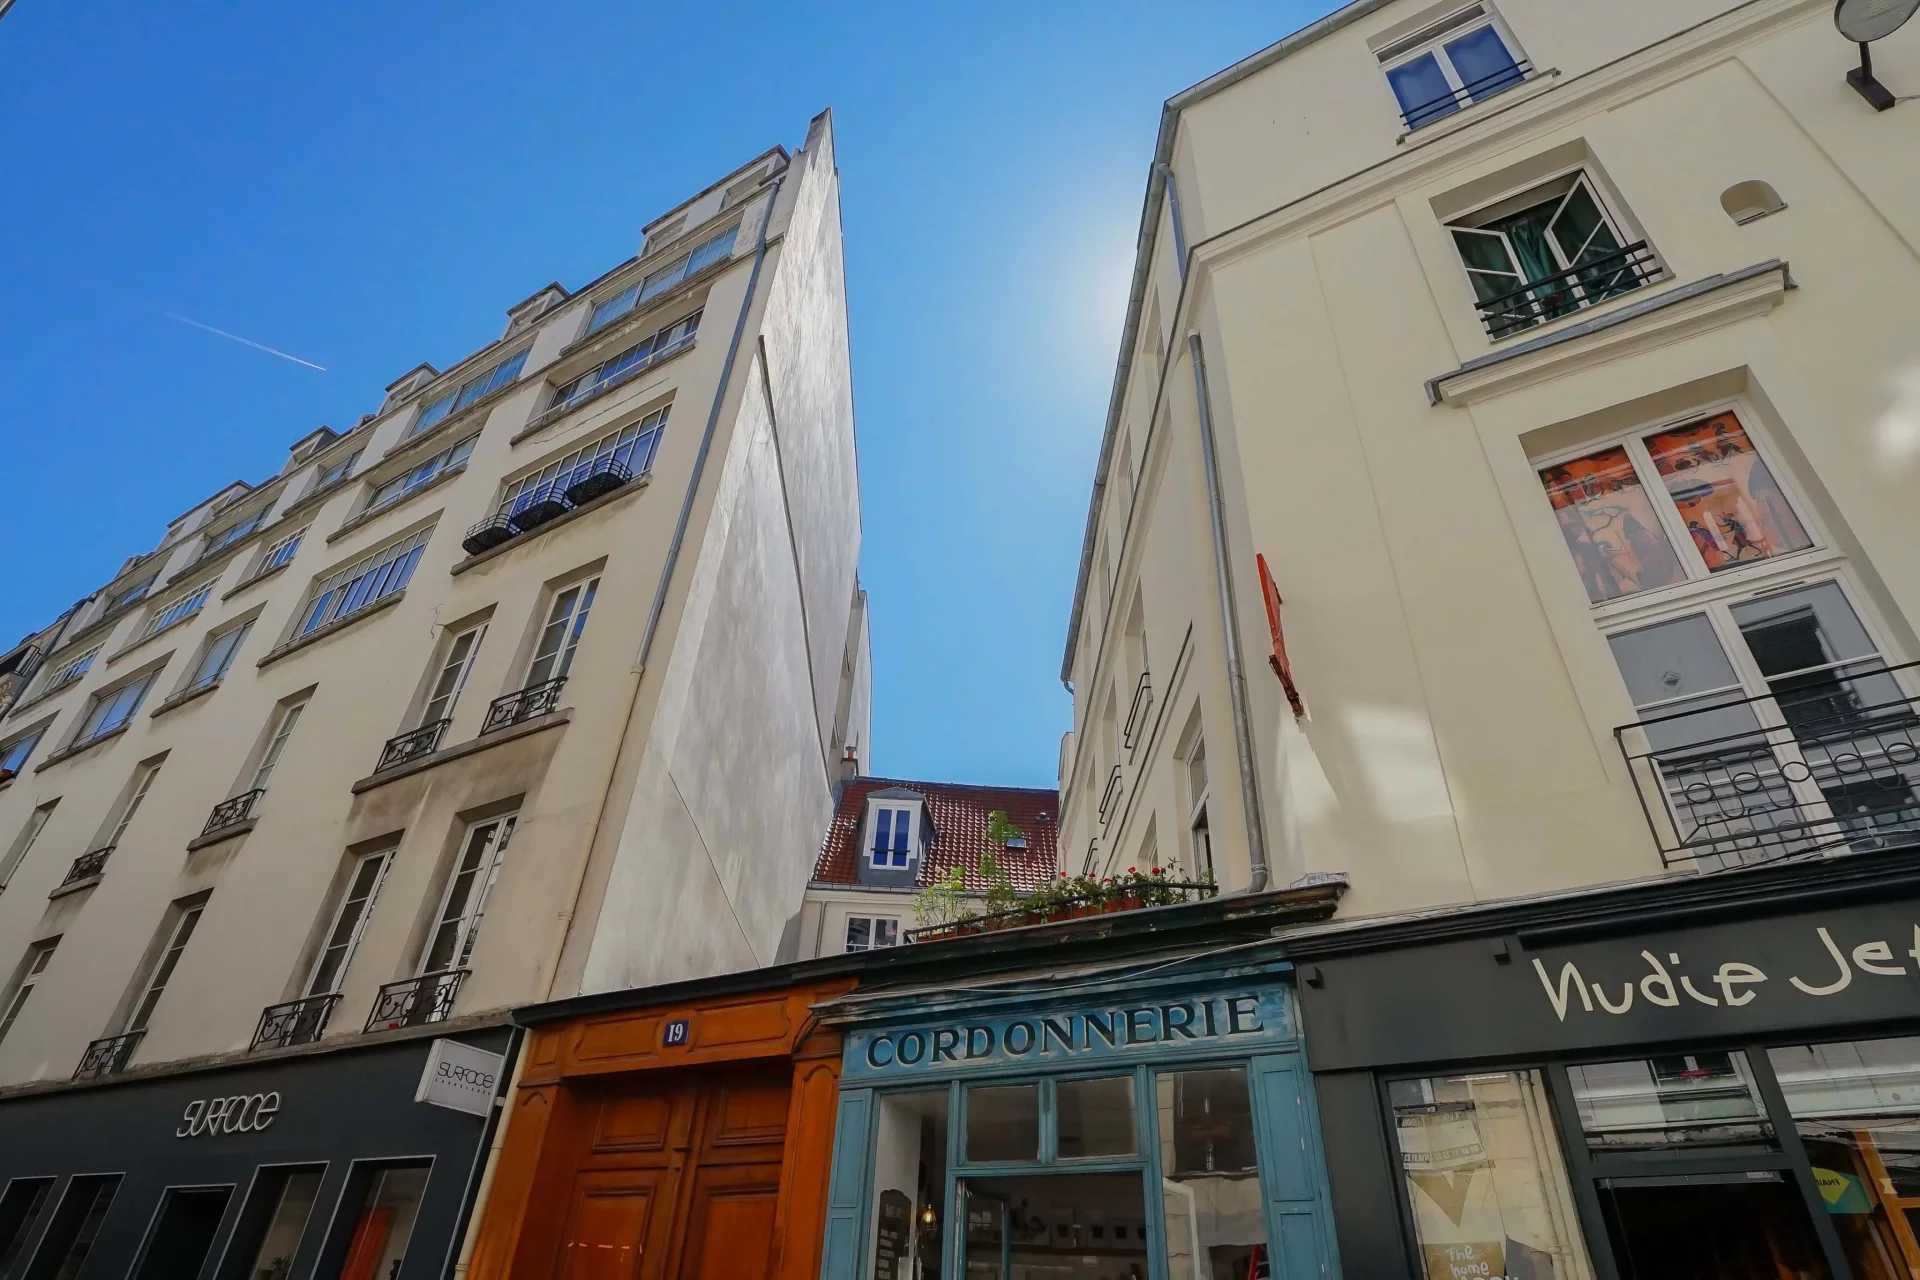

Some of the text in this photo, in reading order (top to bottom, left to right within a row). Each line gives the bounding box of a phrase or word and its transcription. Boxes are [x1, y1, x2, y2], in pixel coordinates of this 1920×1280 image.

[1532, 949, 1768, 1022] Nudie
[668, 1023, 684, 1042] 19
[865, 995, 1266, 1069] CORDONNERIE
[1445, 1244, 1474, 1262] The
[1450, 1261, 1489, 1277] home
